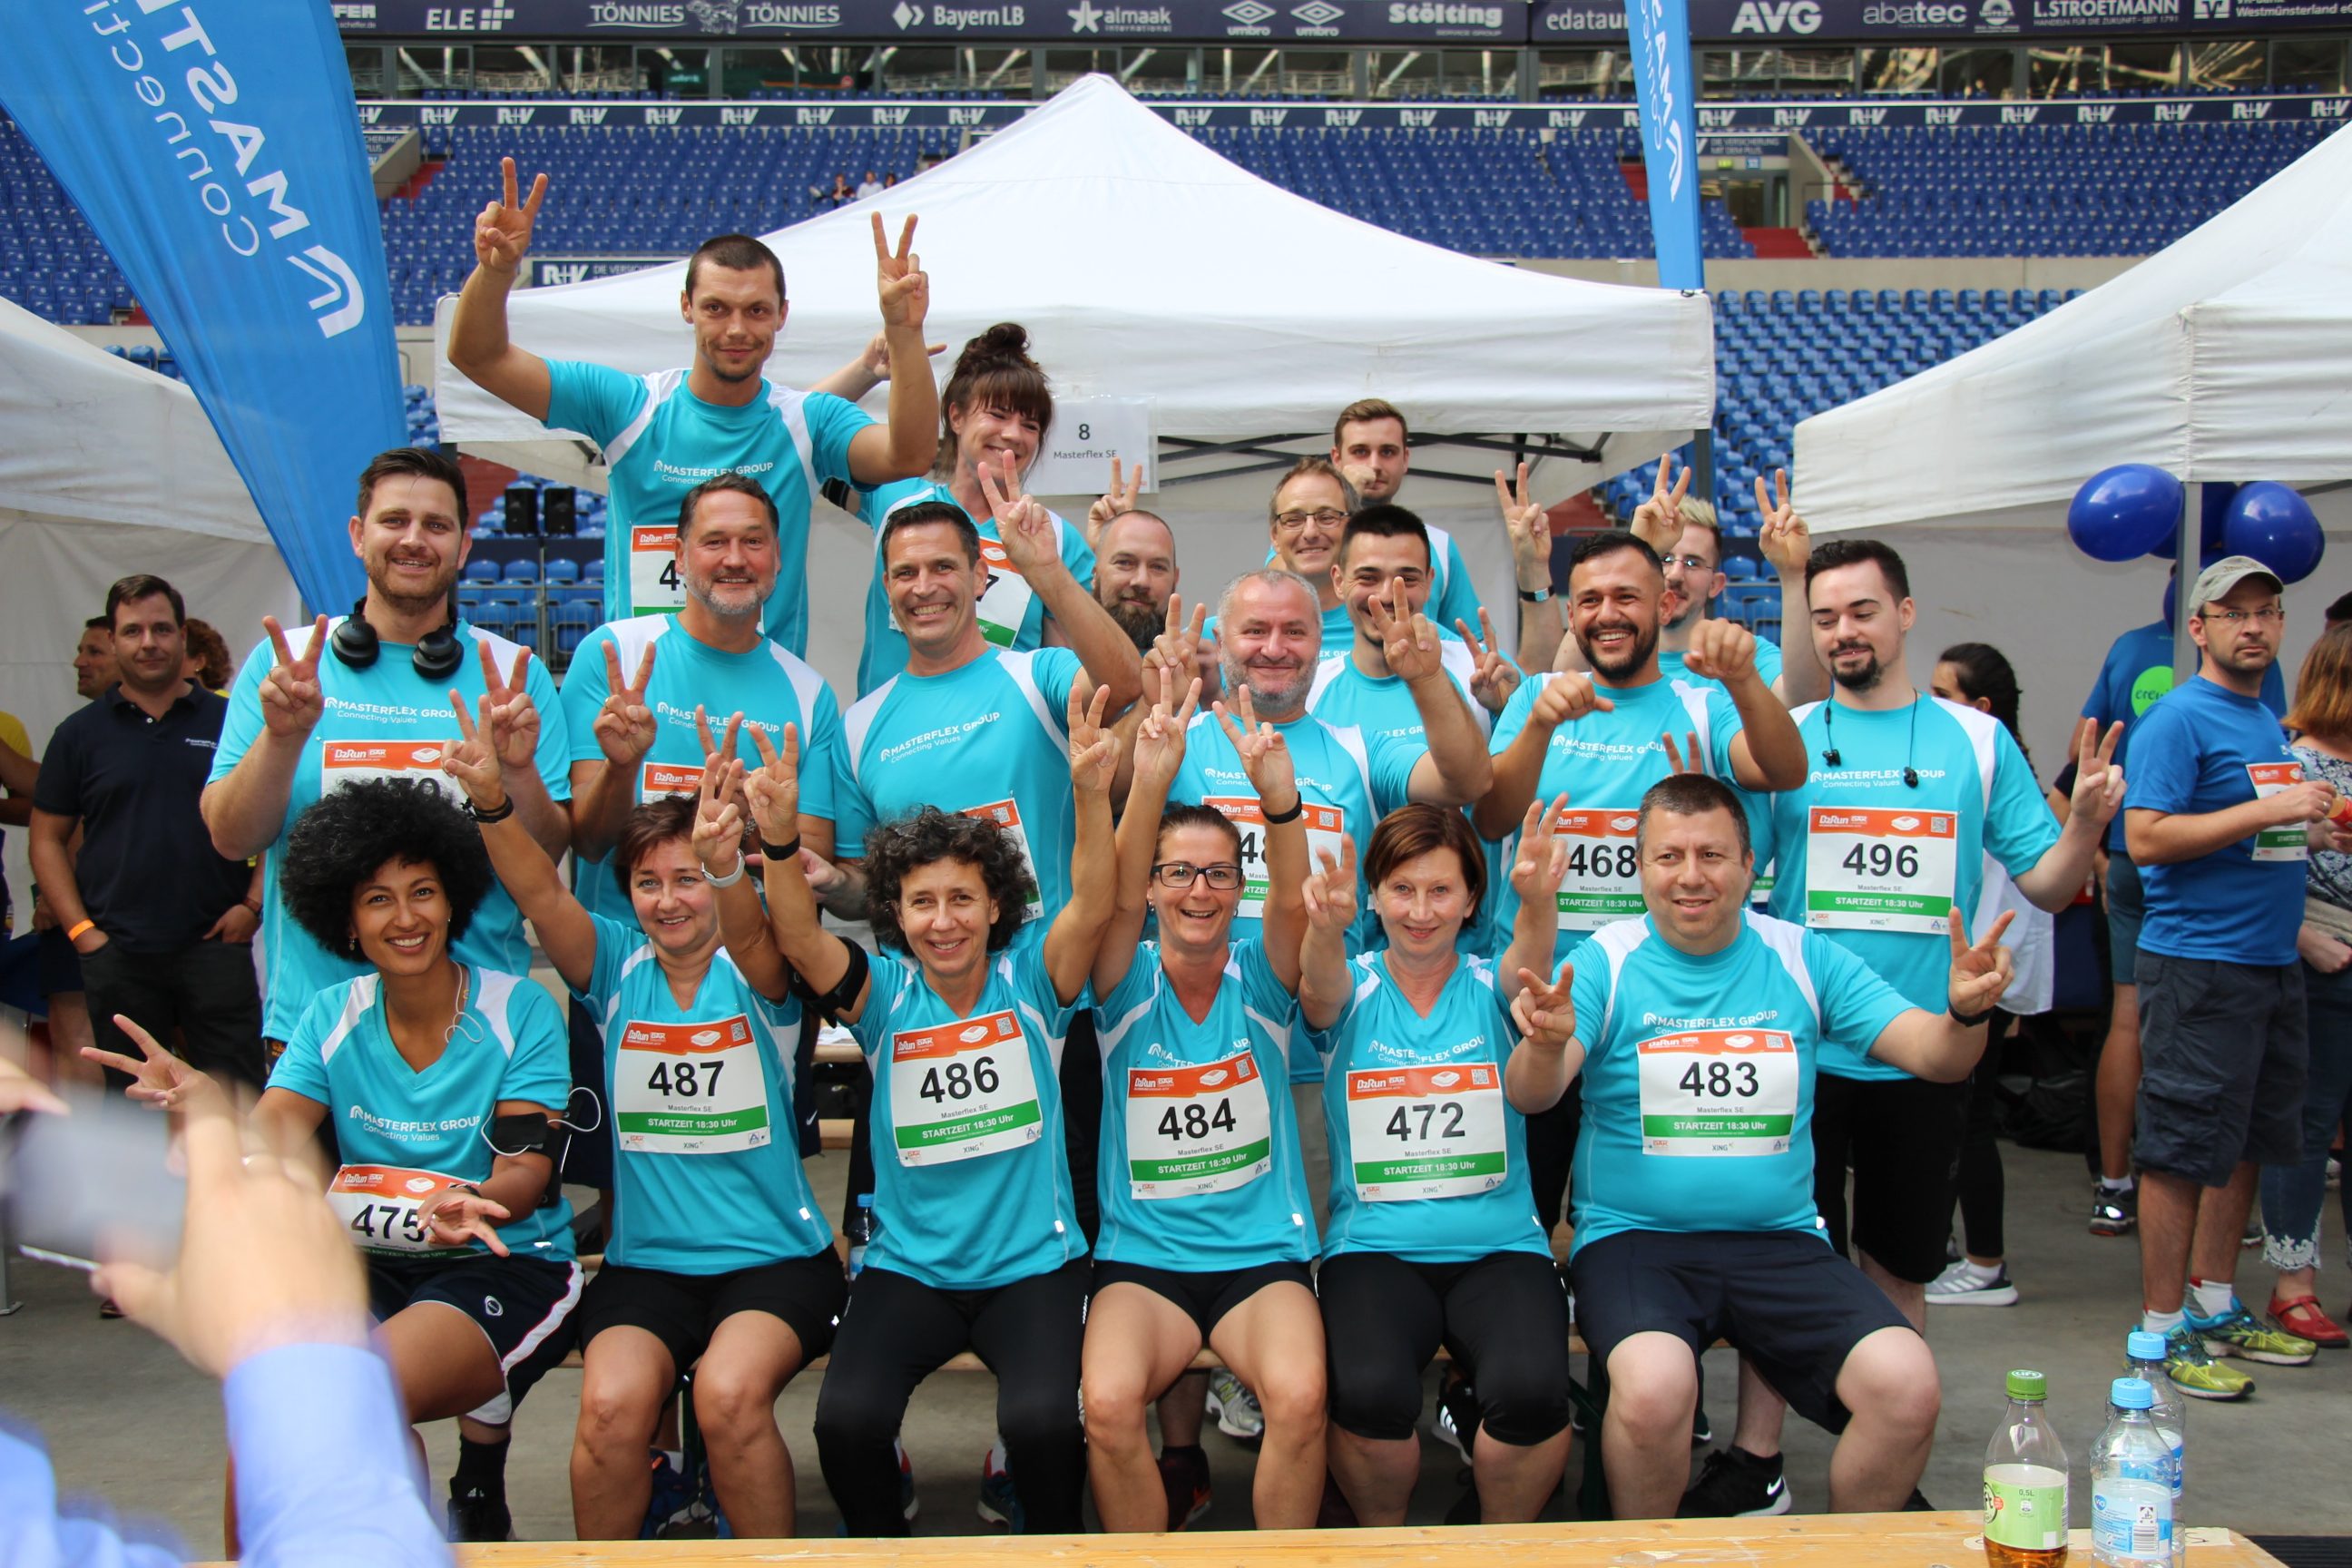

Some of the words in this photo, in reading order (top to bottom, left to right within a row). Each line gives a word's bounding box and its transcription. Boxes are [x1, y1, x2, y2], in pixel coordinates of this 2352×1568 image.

[332, 5, 376, 18] FER
[426, 8, 475, 30] ELE
[590, 2, 684, 23] TÖNNIES
[746, 3, 839, 24] TÖNNIES
[1103, 7, 1171, 24] almaak
[1388, 3, 1503, 28] Stölting
[1730, 1, 1822, 34] AVG
[1863, 1, 1967, 24] abatec
[2236, 4, 2338, 17] Westmünsterland
[1227, 26, 1270, 36] umbro
[1296, 26, 1339, 36] umbro
[359, 107, 382, 124] +V
[421, 107, 459, 124] R+V
[497, 107, 535, 124] R+V
[570, 107, 608, 125] R+V
[645, 107, 683, 125] R+V
[720, 107, 759, 125] R+V
[797, 107, 835, 125] R+V
[873, 108, 911, 125] R+V
[948, 108, 987, 125] R+V
[1849, 108, 1887, 125] R+V
[1925, 107, 1964, 125] R+V
[2001, 106, 2040, 123] R+V
[2077, 105, 2116, 123] R+V
[2155, 103, 2193, 122] R+V
[2232, 102, 2271, 120] R+V
[2311, 99, 2351, 118] R+V
[1175, 109, 1212, 126] R+V
[1250, 109, 1289, 126] R+V
[1325, 109, 1363, 127] R+V
[1400, 110, 1438, 127] R+V
[1475, 110, 1513, 127] R+V
[1548, 110, 1587, 127] R+V
[1699, 110, 1737, 127] R+V
[1774, 109, 1812, 126] R+V
[542, 264, 589, 285] R+V
[1078, 424, 1091, 440] 8
[1054, 450, 1103, 459] Masterflex
[1106, 450, 1117, 458] SE
[736, 462, 774, 475] GROUP
[337, 710, 387, 724] Connecting
[390, 716, 417, 724] Values
[338, 701, 418, 716] MASTERFLEX
[421, 708, 456, 719] GROU
[891, 725, 960, 756] MASTERFLEX
[891, 741, 933, 763] Connecting
[935, 734, 962, 747] Values
[1565, 739, 1633, 754] MASTERFLEX
[1562, 748, 1605, 761] Connecting
[1822, 769, 1900, 780] MASTERFLEX
[1822, 779, 1871, 789] Connecting
[1873, 779, 1900, 788] Values
[1569, 844, 1637, 878] 468
[1842, 842, 1919, 878] 496
[1559, 897, 1603, 906] STARTZEIT
[1605, 899, 1626, 907] 18:30
[1629, 899, 1642, 907] Uhr
[1835, 897, 1883, 906] STARTZEIT
[1884, 899, 1906, 908] 18:30
[1908, 900, 1924, 908] Uhr
[1658, 1016, 1736, 1028] MASTERFLEX
[1739, 1010, 1778, 1026] GROUP
[1453, 1034, 1485, 1054] GROU
[648, 1060, 724, 1097] 487
[919, 1056, 999, 1103] 486
[1679, 1062, 1759, 1097] 483
[941, 1106, 977, 1119] Masterflex
[978, 1103, 988, 1112] SE
[1158, 1097, 1237, 1141] 484
[364, 1111, 437, 1132] MASTERFLEX
[440, 1115, 481, 1131] GROUP
[648, 1118, 693, 1128] STARTZEIT
[696, 1120, 719, 1128] 18:30
[720, 1119, 738, 1127] Uhr
[922, 1122, 971, 1139] STARTZEIT
[973, 1119, 997, 1130] 18:30
[998, 1113, 1014, 1126] Uhr
[1386, 1102, 1465, 1142] 472
[1673, 1122, 1724, 1131] STARTZEIT
[1726, 1122, 1749, 1130] 18:30
[363, 1122, 408, 1142] Connecting
[411, 1132, 440, 1142] Values
[1177, 1146, 1213, 1156] Masterflex
[1158, 1161, 1206, 1174] STARTZEIT
[1208, 1158, 1231, 1169] 18:30
[1232, 1152, 1249, 1163] Uhr
[1384, 1165, 1434, 1176] STARTZEIT
[1435, 1162, 1458, 1171] 18:30
[1459, 1161, 1476, 1170] Uhr
[350, 1203, 426, 1243] 475
